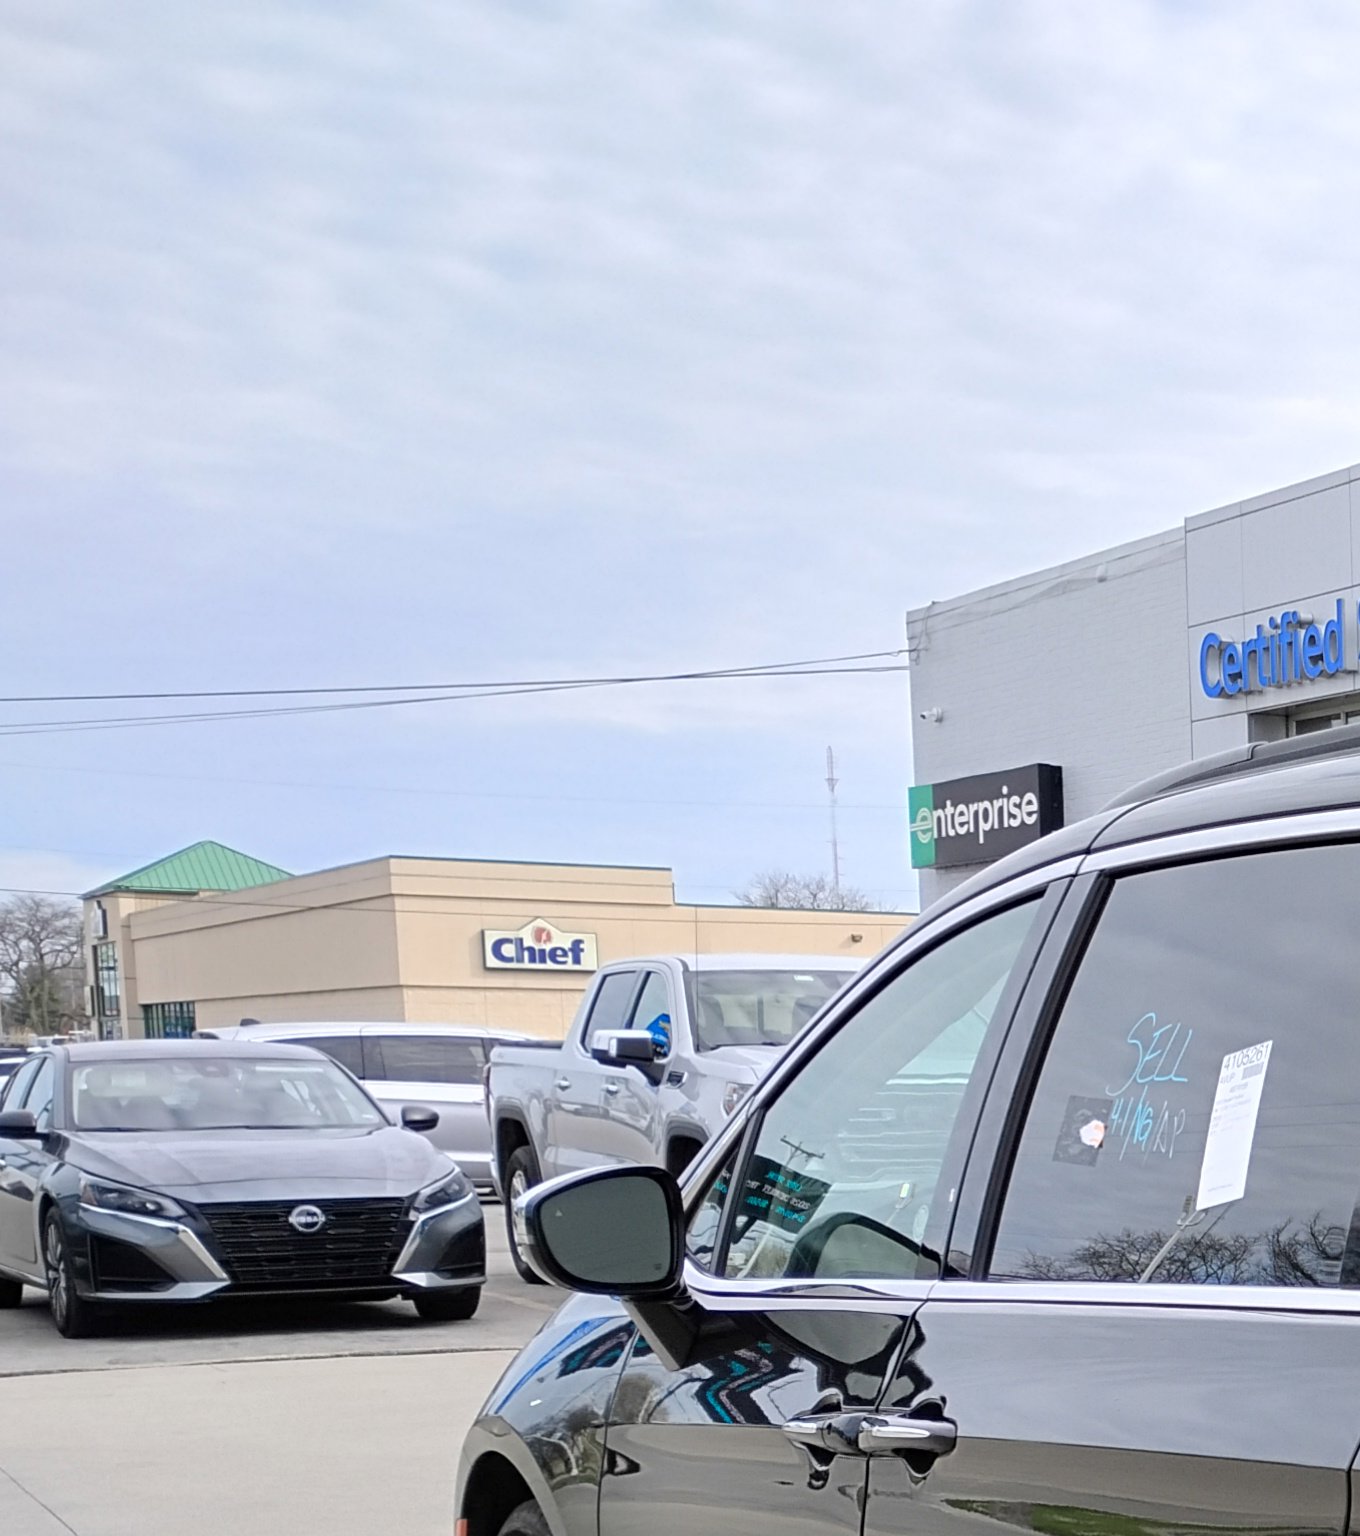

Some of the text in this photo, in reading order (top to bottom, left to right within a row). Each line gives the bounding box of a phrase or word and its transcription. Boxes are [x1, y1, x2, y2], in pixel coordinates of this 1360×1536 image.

[1200, 598, 1348, 699] Certified
[910, 785, 1039, 844] enterprise
[491, 937, 585, 965] Chief
[1106, 1012, 1192, 1096] SELL
